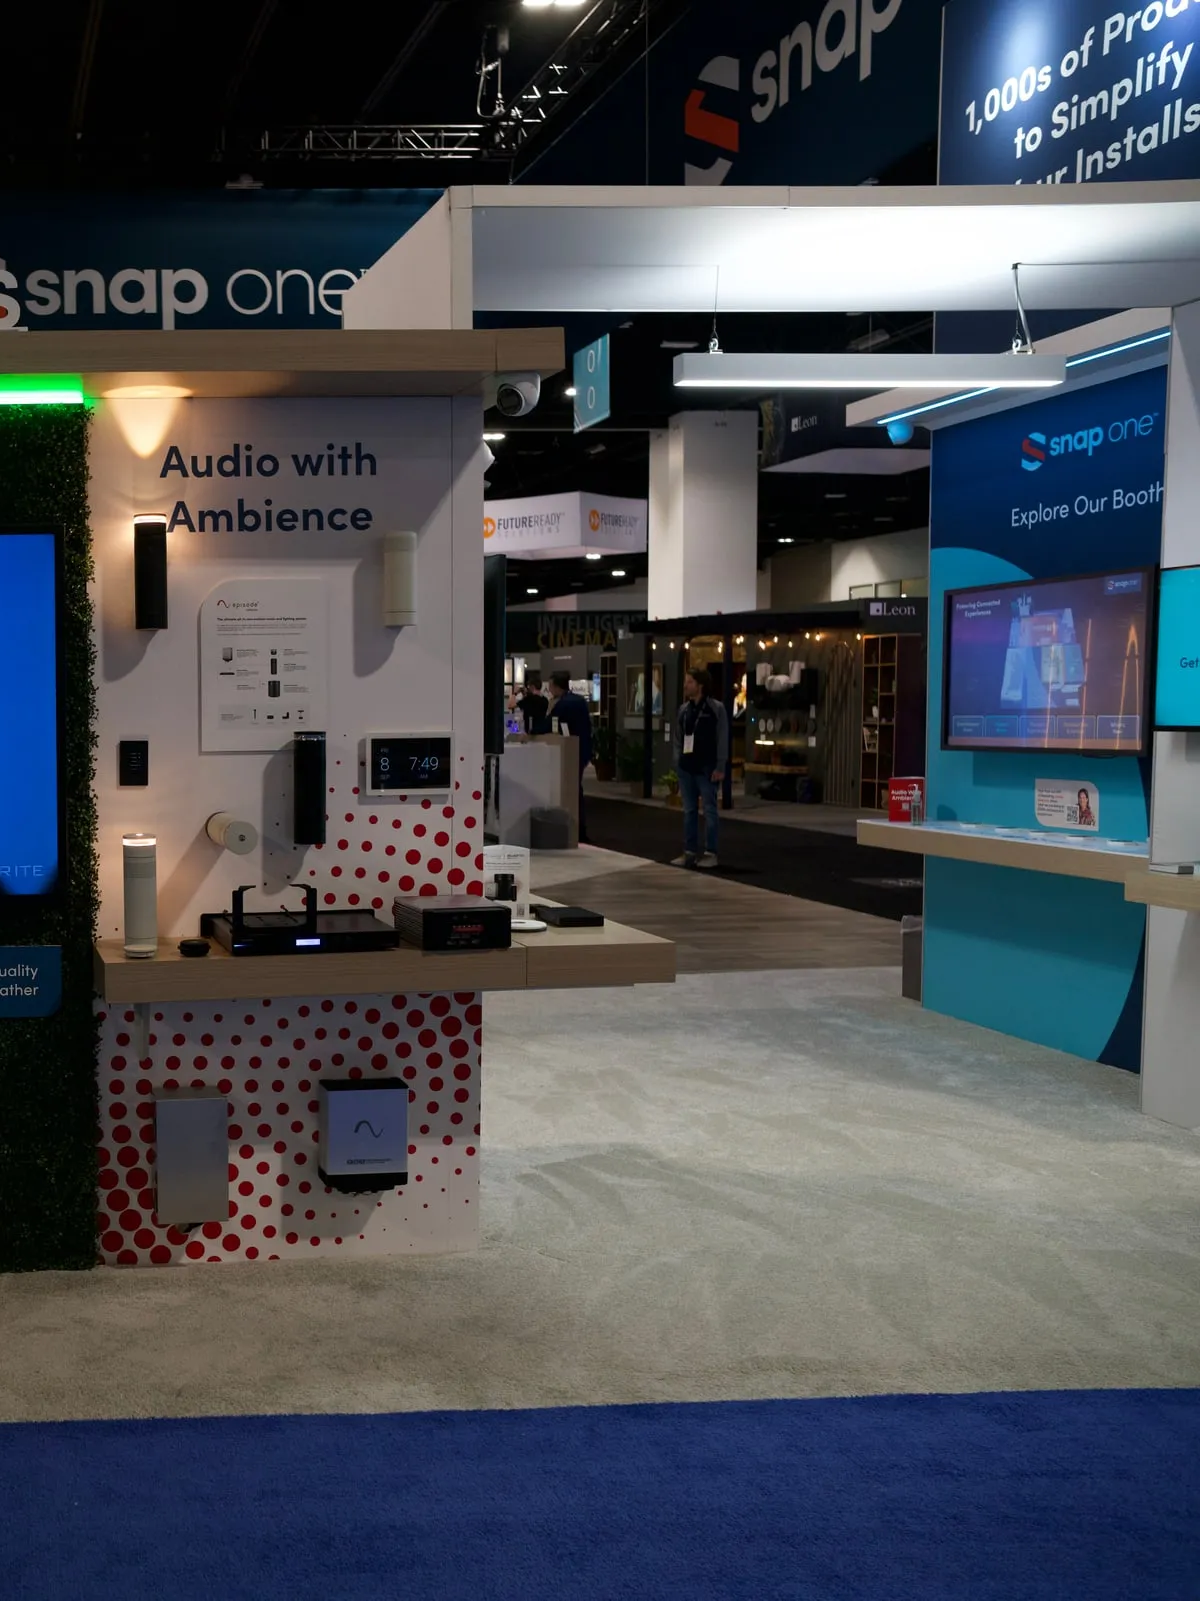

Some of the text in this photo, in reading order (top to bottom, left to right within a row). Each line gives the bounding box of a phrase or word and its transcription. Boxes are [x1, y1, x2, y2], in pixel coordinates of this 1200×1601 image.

[751, 0, 902, 123] snap
[965, 0, 1200, 135] 1,000s of Pro
[1014, 40, 1194, 159] to Simplify
[1076, 98, 1200, 184] Installs
[25, 268, 358, 330] snap one
[1050, 414, 1154, 457] snap one
[160, 442, 377, 478] Audio with
[167, 498, 373, 533] Ambience
[497, 513, 561, 530] FUTUREREADY
[1011, 481, 1164, 530] Explore Our Booth
[883, 602, 916, 616] Leon
[1180, 656, 1200, 669] Get
[380, 756, 439, 771] 8 7:49
